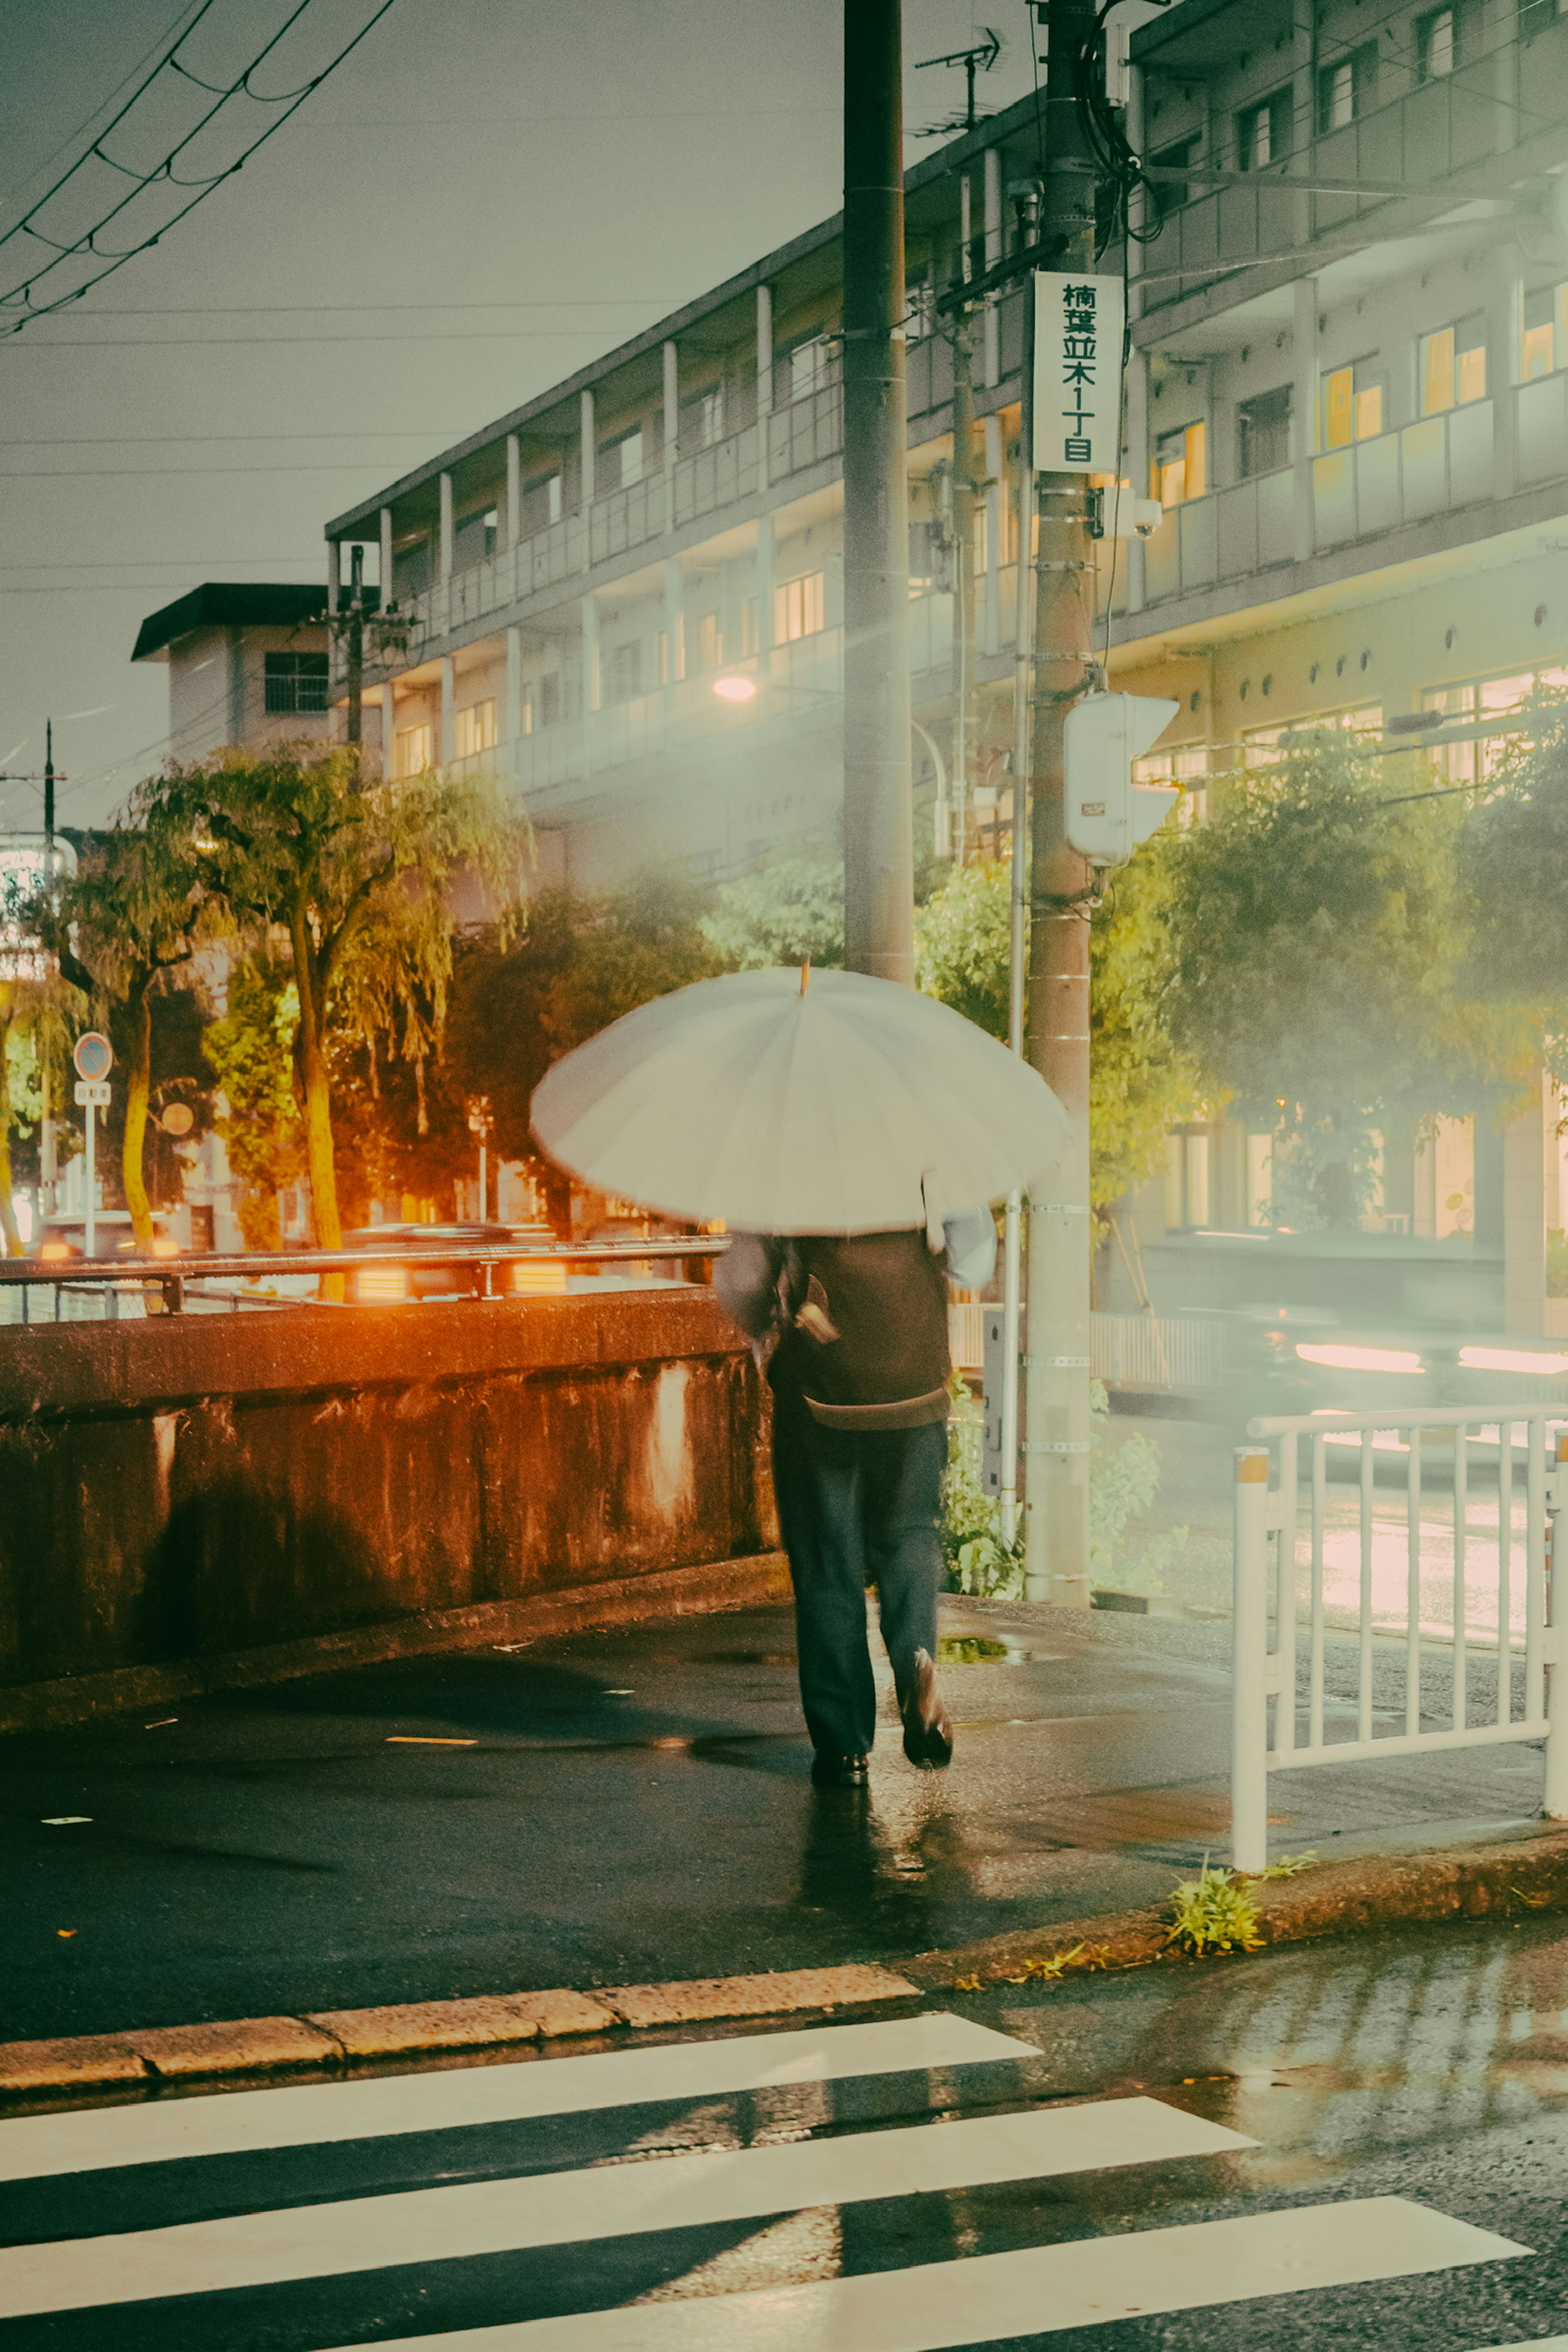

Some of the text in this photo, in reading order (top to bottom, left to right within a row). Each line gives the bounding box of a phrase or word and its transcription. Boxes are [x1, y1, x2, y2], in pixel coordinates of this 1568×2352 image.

[1062, 284, 1097, 462] 楠葉並木1丁目
